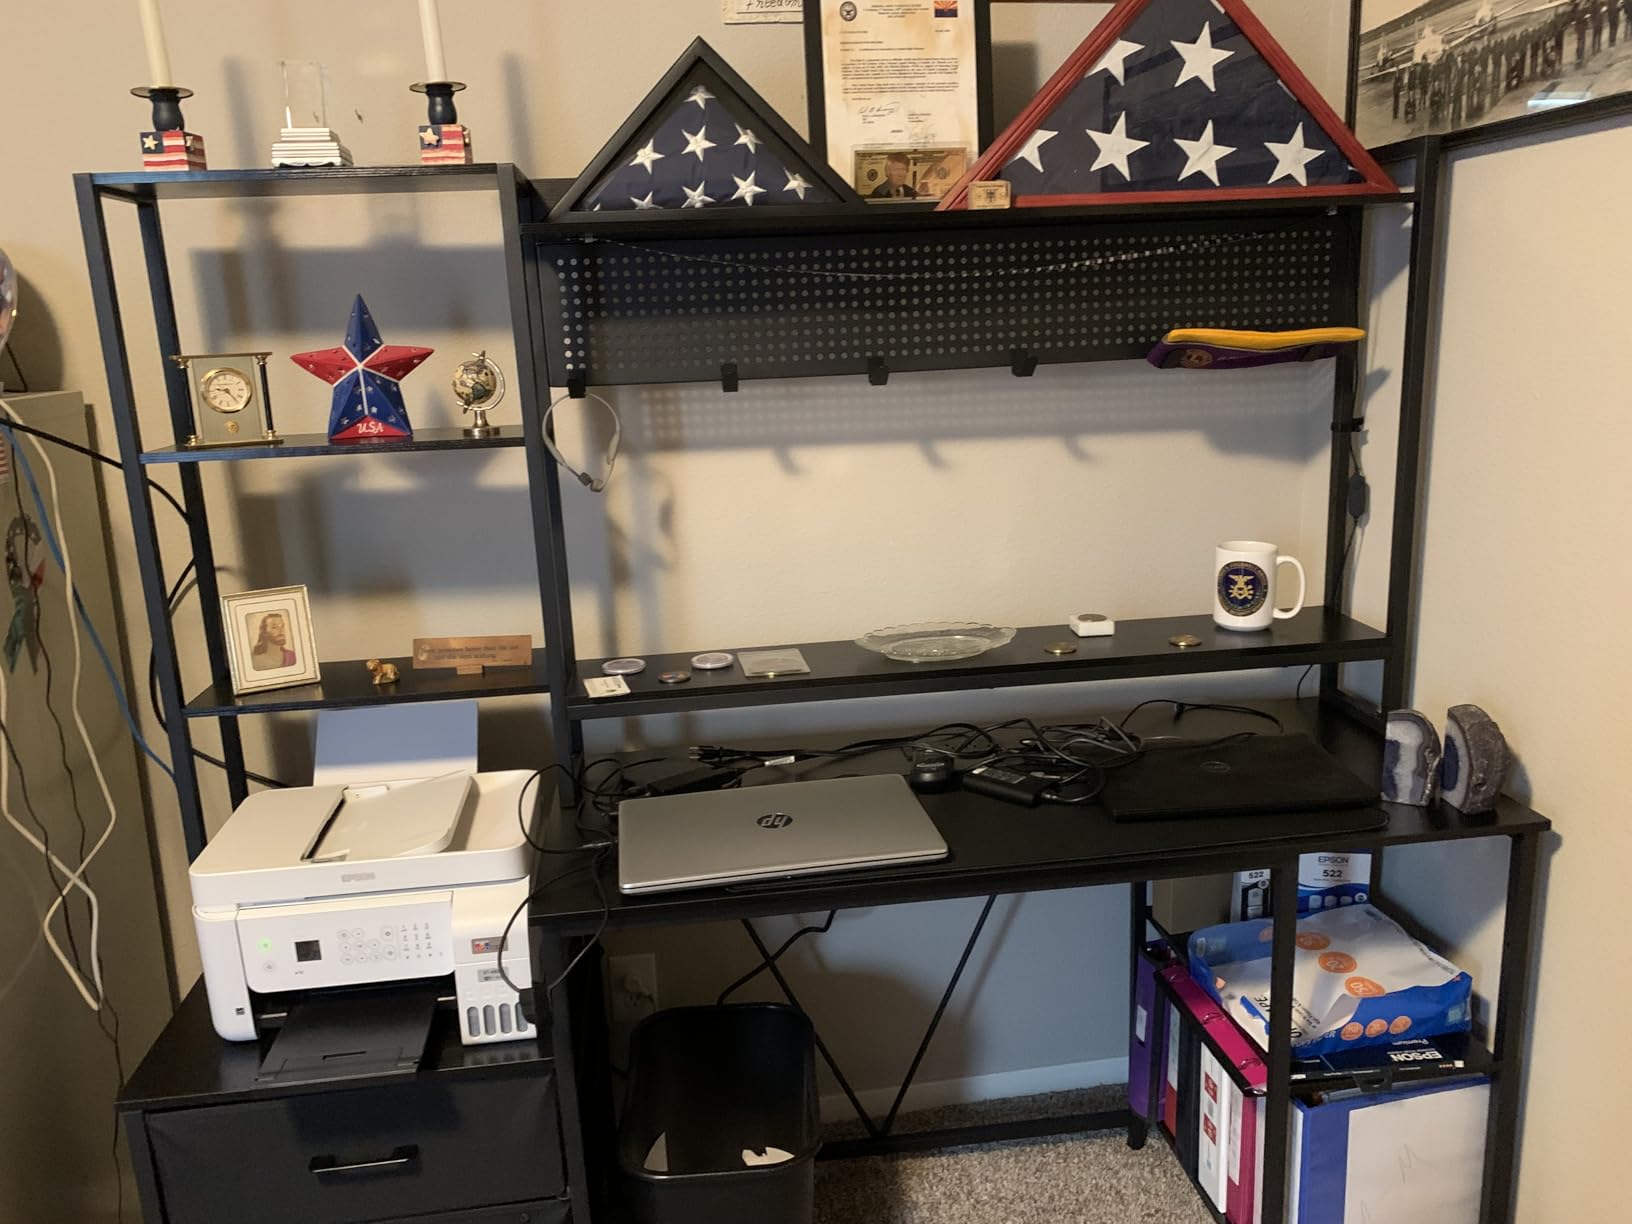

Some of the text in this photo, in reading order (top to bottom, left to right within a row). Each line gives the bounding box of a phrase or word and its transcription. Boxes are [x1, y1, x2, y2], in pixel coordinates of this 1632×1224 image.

[356, 421, 384, 434] USA
[1318, 855, 1349, 864] EPSON
[1248, 871, 1264, 879] 522
[1322, 869, 1343, 878] 522
[1390, 1051, 1443, 1062] EPSON
